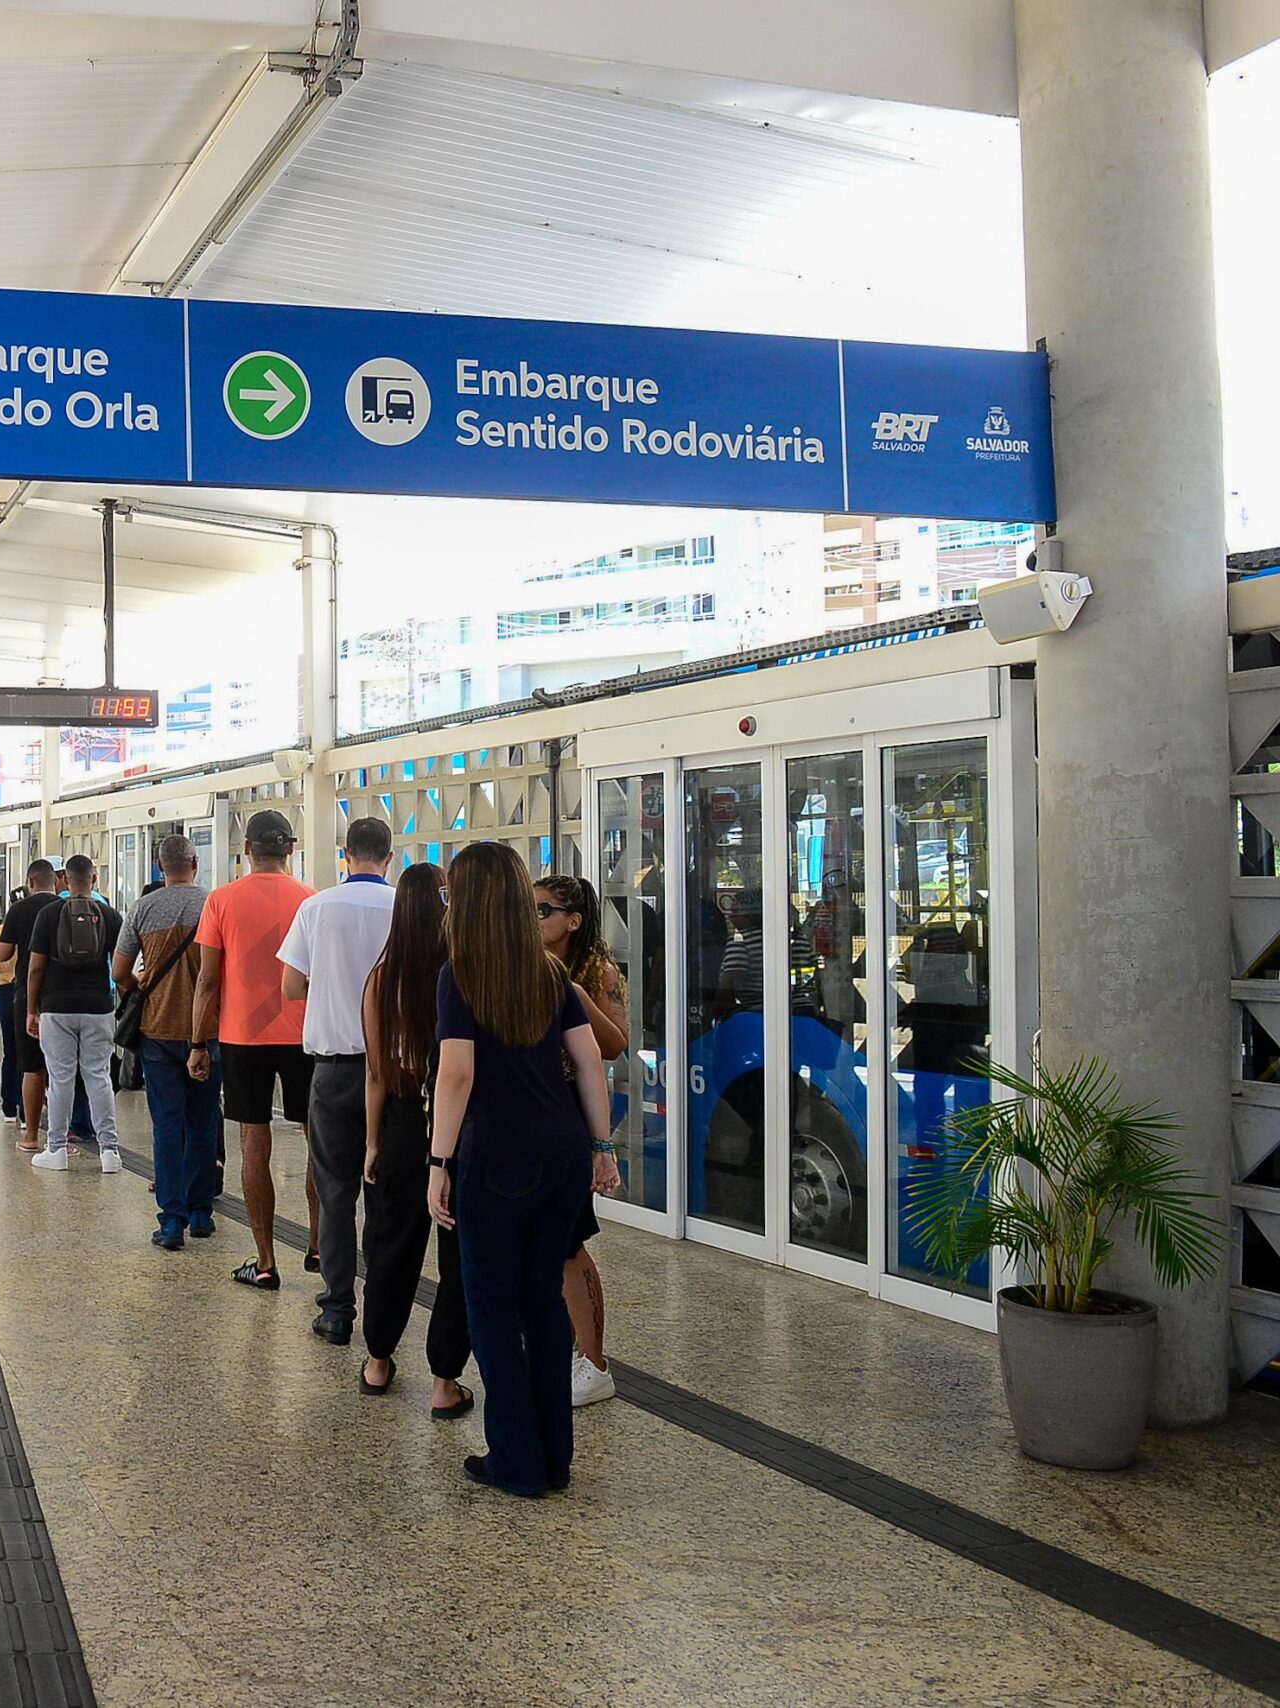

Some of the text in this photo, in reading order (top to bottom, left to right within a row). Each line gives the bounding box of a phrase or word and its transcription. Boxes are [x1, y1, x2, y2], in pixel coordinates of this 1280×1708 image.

[456, 358, 659, 412] Embarque
[65, 391, 160, 432] Orla
[455, 409, 825, 464] Sentido Rodoviária
[871, 412, 939, 441] BRT
[871, 441, 926, 453] SALVADOR
[966, 437, 1030, 453] SALVADOR
[975, 452, 1021, 462] PREFEITURA
[94, 697, 151, 718] 11:53
